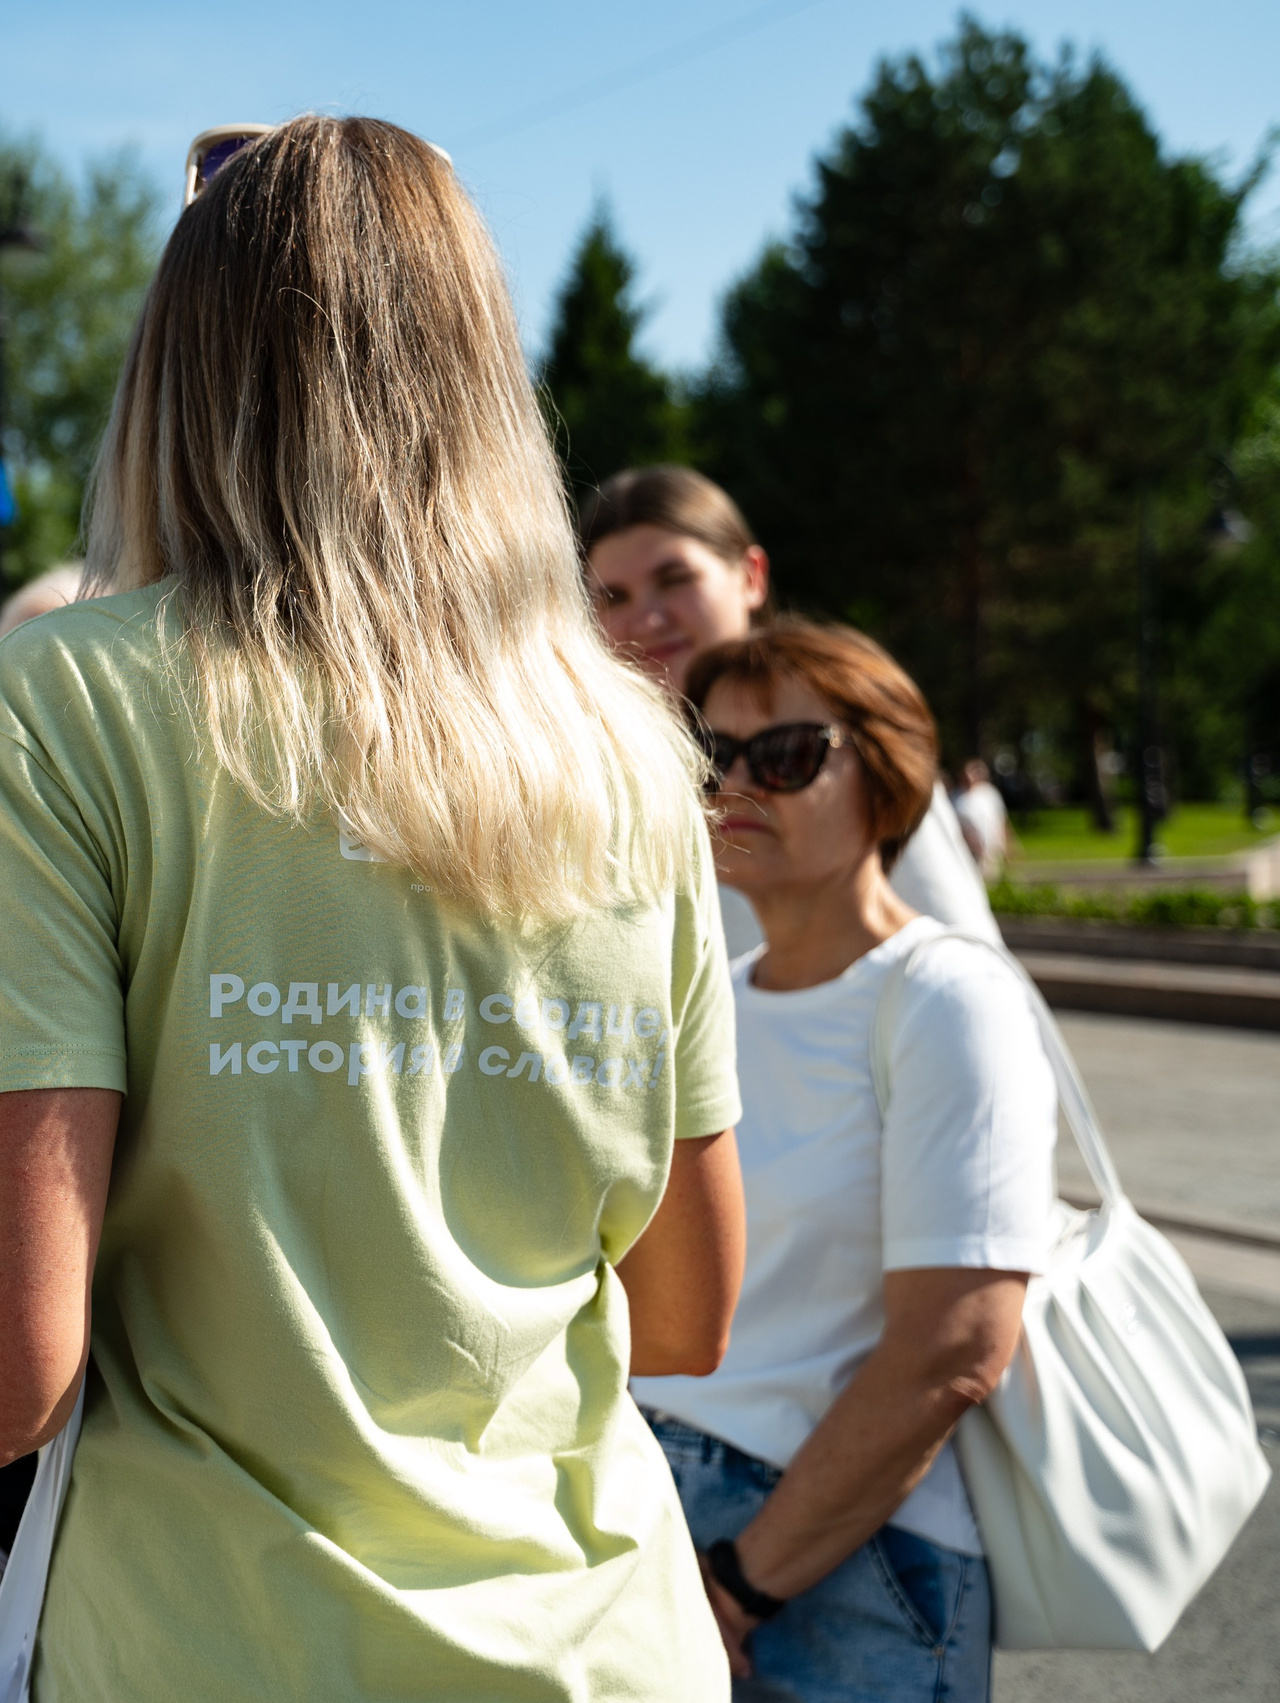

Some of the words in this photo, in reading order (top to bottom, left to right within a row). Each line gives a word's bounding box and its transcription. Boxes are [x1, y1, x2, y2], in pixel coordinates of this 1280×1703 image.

[209, 973, 427, 1024] Родина
[443, 988, 465, 1020] в
[479, 993, 669, 1047] сердце,
[209, 1039, 435, 1086] история
[443, 1042, 464, 1073] в
[478, 1045, 666, 1089] словах!
